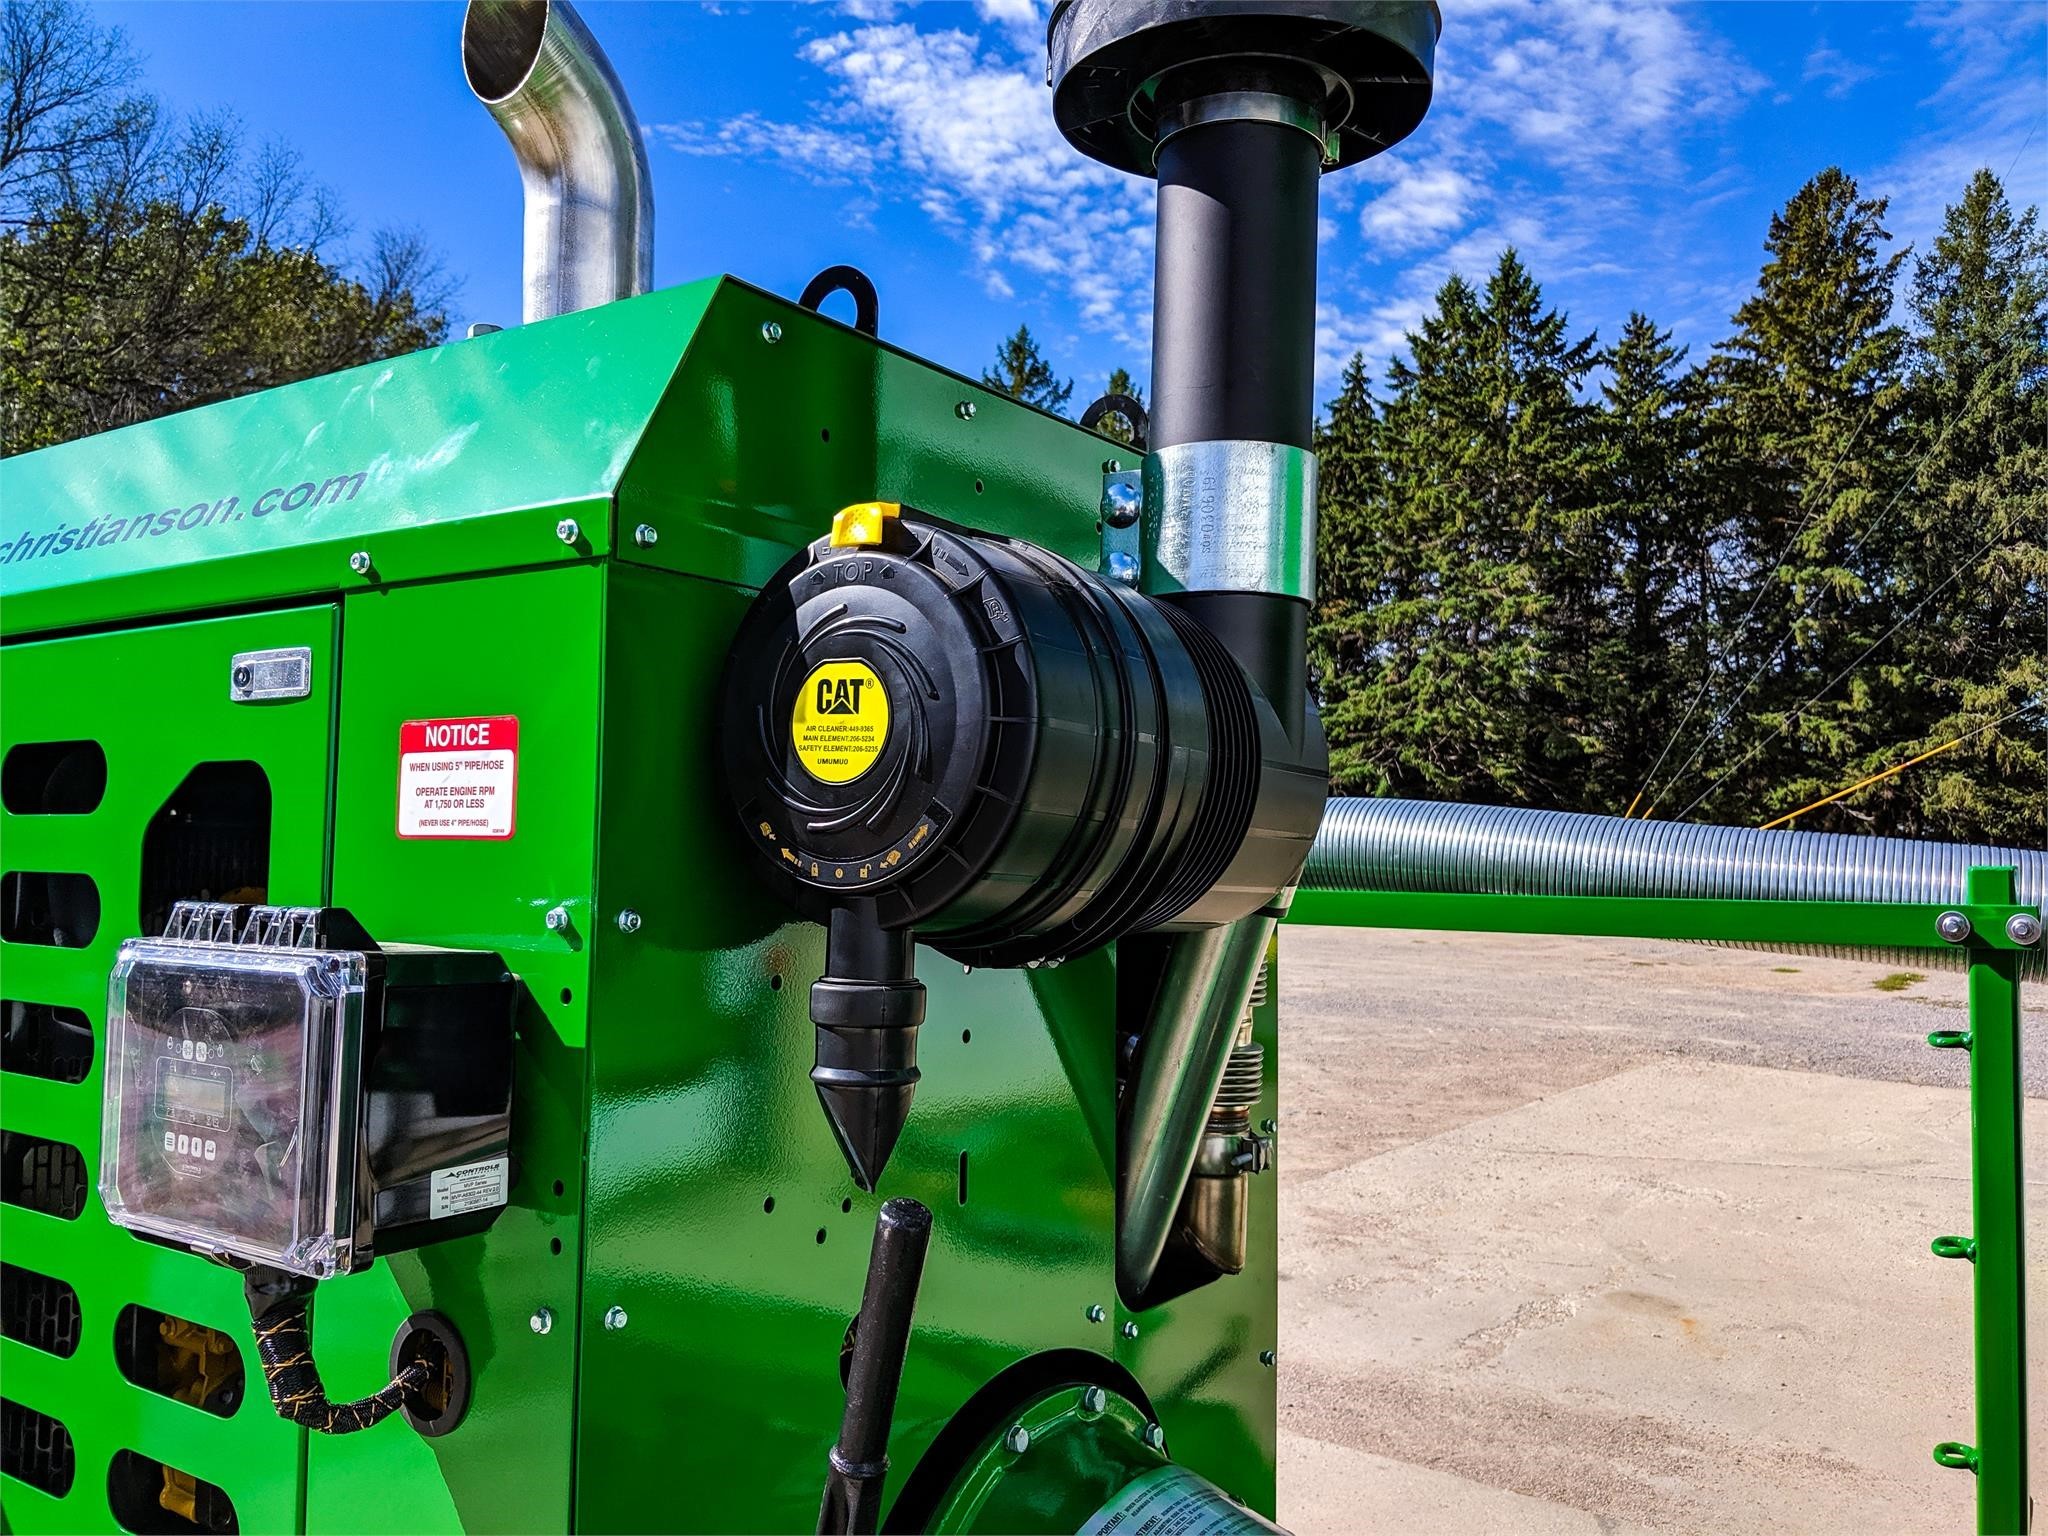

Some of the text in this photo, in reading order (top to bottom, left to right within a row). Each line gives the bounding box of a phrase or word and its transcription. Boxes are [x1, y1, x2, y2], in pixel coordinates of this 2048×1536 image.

[833, 561, 873, 583] TOP
[425, 723, 490, 747] NOTICE
[409, 762, 430, 772] WHEN
[431, 761, 454, 772] USING
[464, 760, 504, 770] PIPE/HOSE
[415, 786, 495, 797] OPERATE ENGINE RPM
[424, 798, 485, 810] AT 1,750 OR LESS
[418, 819, 439, 828] (NEVER
[439, 819, 450, 827] USE
[457, 818, 489, 828] PIPE/HOSE)
